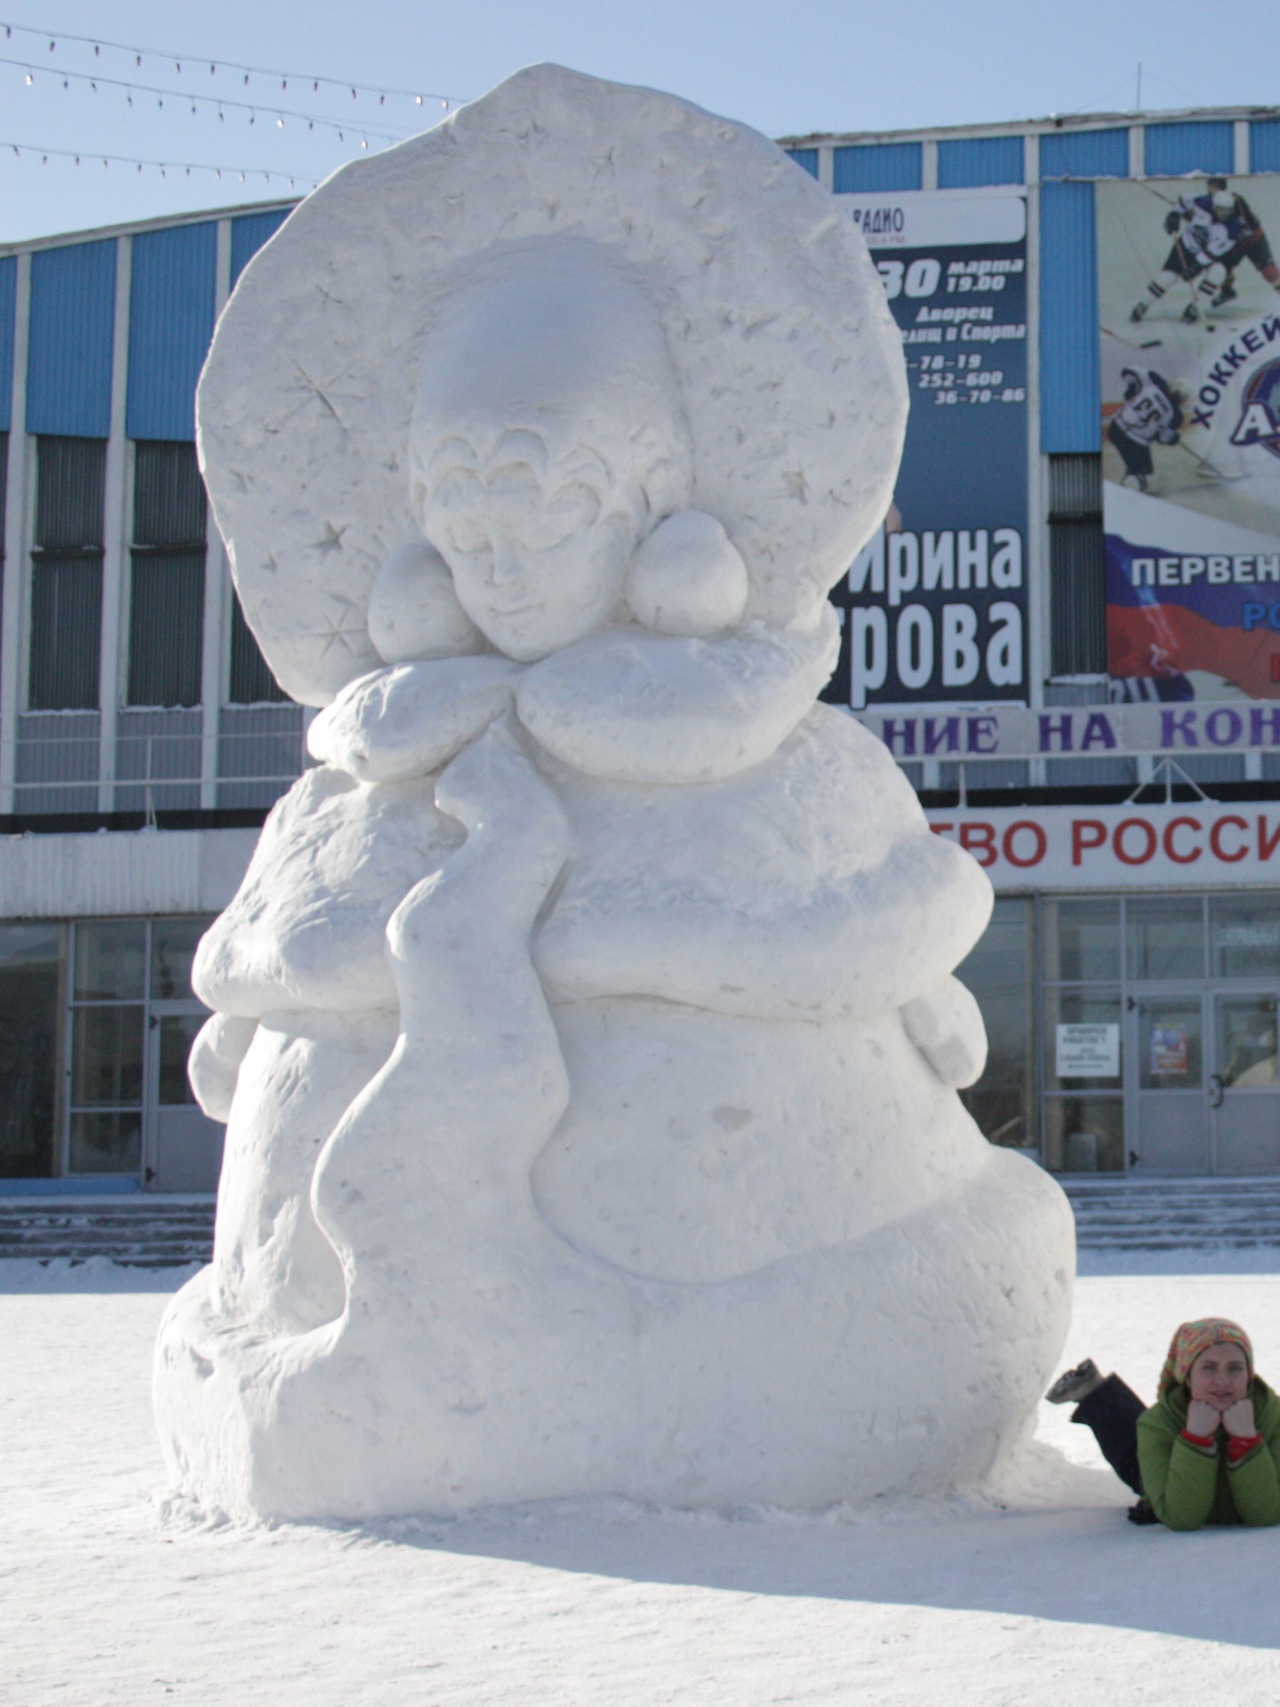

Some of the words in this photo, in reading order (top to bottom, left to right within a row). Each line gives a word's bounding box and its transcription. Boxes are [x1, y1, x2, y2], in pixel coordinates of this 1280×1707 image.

[947, 259, 1024, 276] марта
[877, 258, 941, 299] 30
[947, 275, 1006, 293] 19.00
[916, 306, 993, 324] Дворец
[961, 323, 1026, 343] Спорта
[905, 354, 982, 370] -78-19
[918, 371, 1003, 388] 252-600
[849, 528, 1022, 606] Ирина
[835, 601, 1022, 709] рова
[860, 715, 999, 756] НИЕ
[1039, 712, 1117, 752] НА
